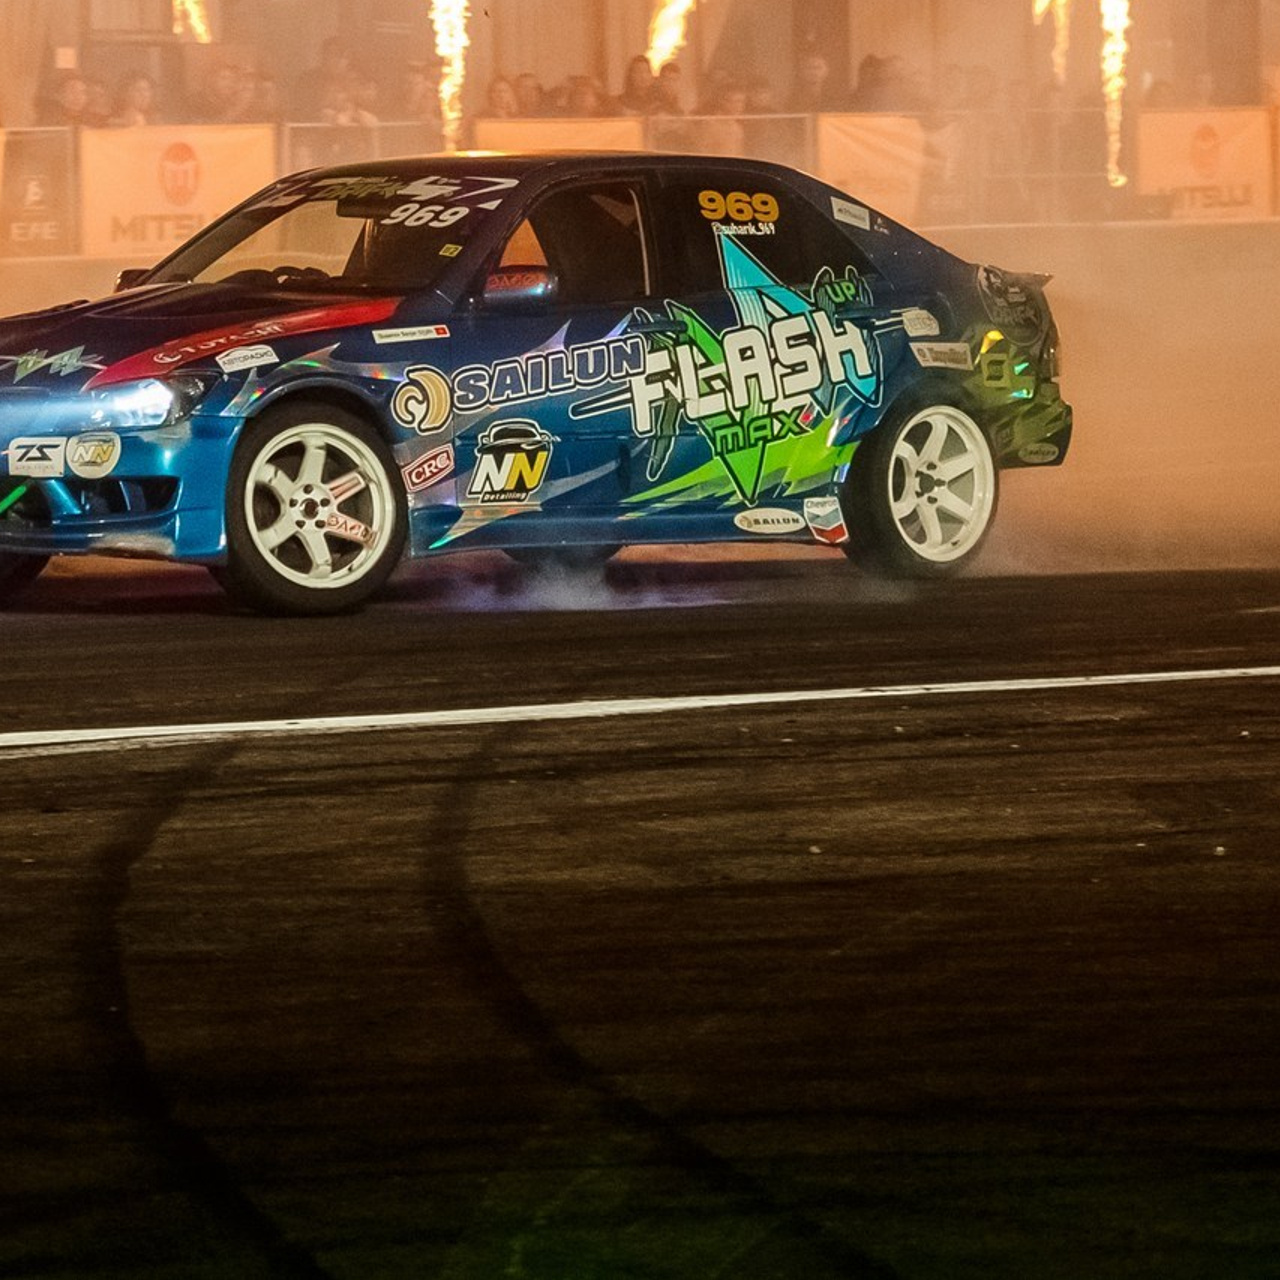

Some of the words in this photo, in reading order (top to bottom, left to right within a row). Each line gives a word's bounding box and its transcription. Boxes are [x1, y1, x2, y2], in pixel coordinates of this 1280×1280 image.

[381, 203, 470, 228] 969
[698, 190, 780, 222] 969
[824, 281, 857, 305] UP
[454, 337, 646, 412] SAILUN
[631, 307, 874, 434] FLASH
[714, 408, 803, 456] MAX
[410, 454, 452, 485] CRC
[469, 450, 549, 495] NN
[482, 491, 528, 503] Detailing
[752, 516, 801, 526] SAILUN
